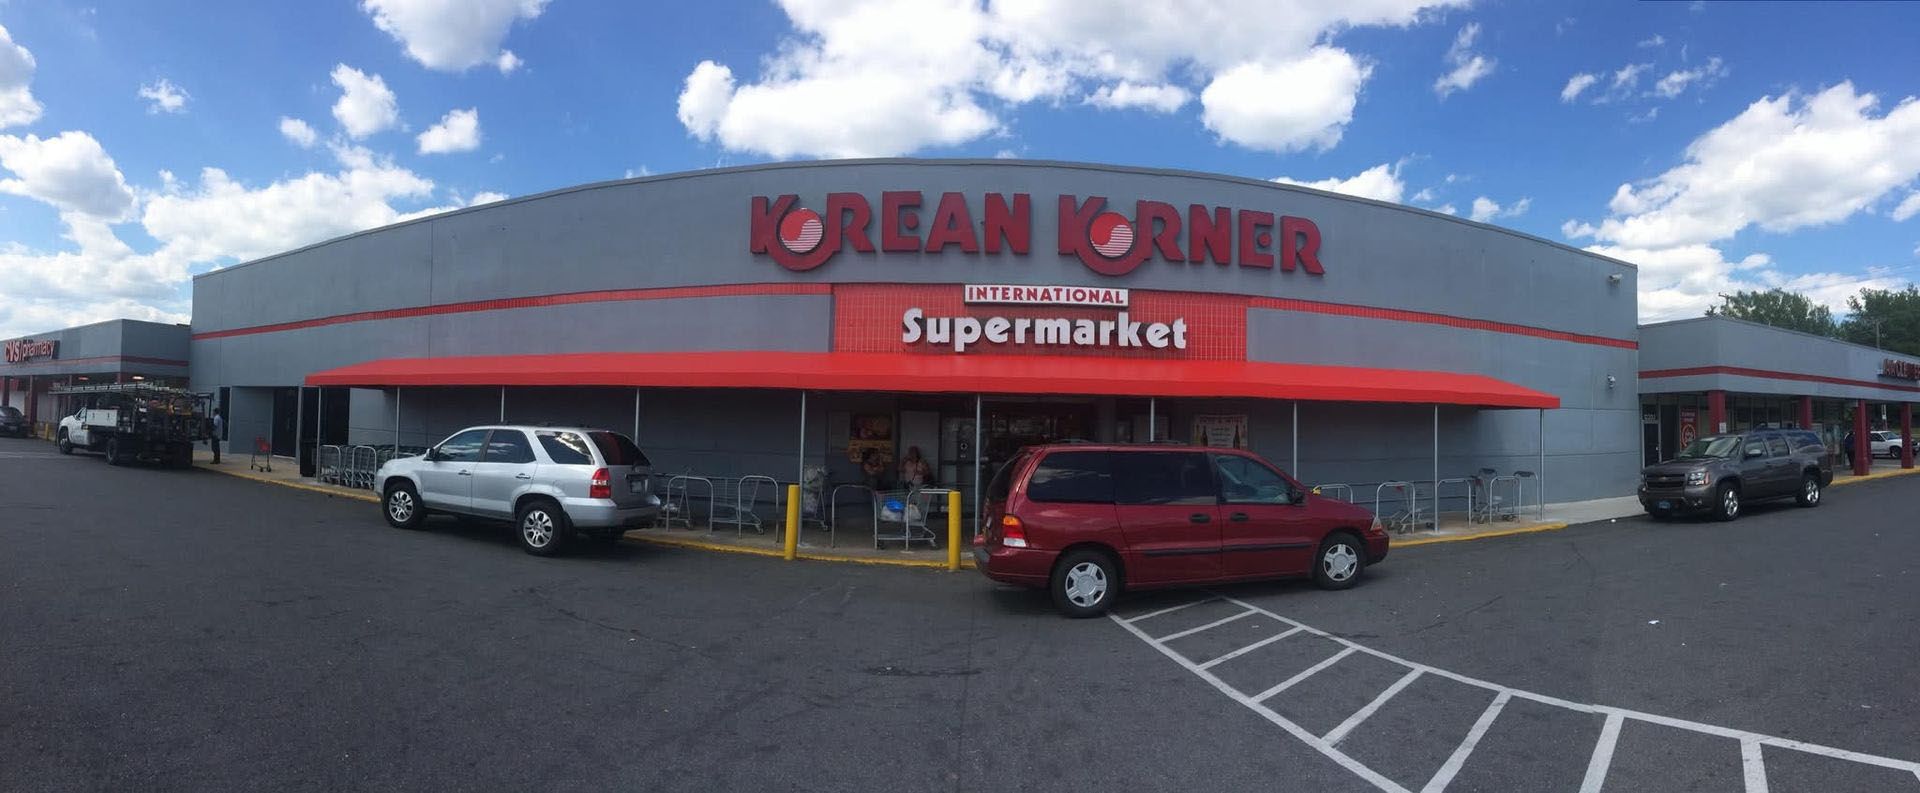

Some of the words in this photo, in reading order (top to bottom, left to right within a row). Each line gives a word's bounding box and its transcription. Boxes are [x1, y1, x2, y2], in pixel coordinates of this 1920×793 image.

[751, 191, 1032, 271] KOREAN
[1058, 194, 1325, 277] KORNER
[968, 286, 1125, 305] INTERNATIONAL
[902, 307, 1188, 352] Supermarket
